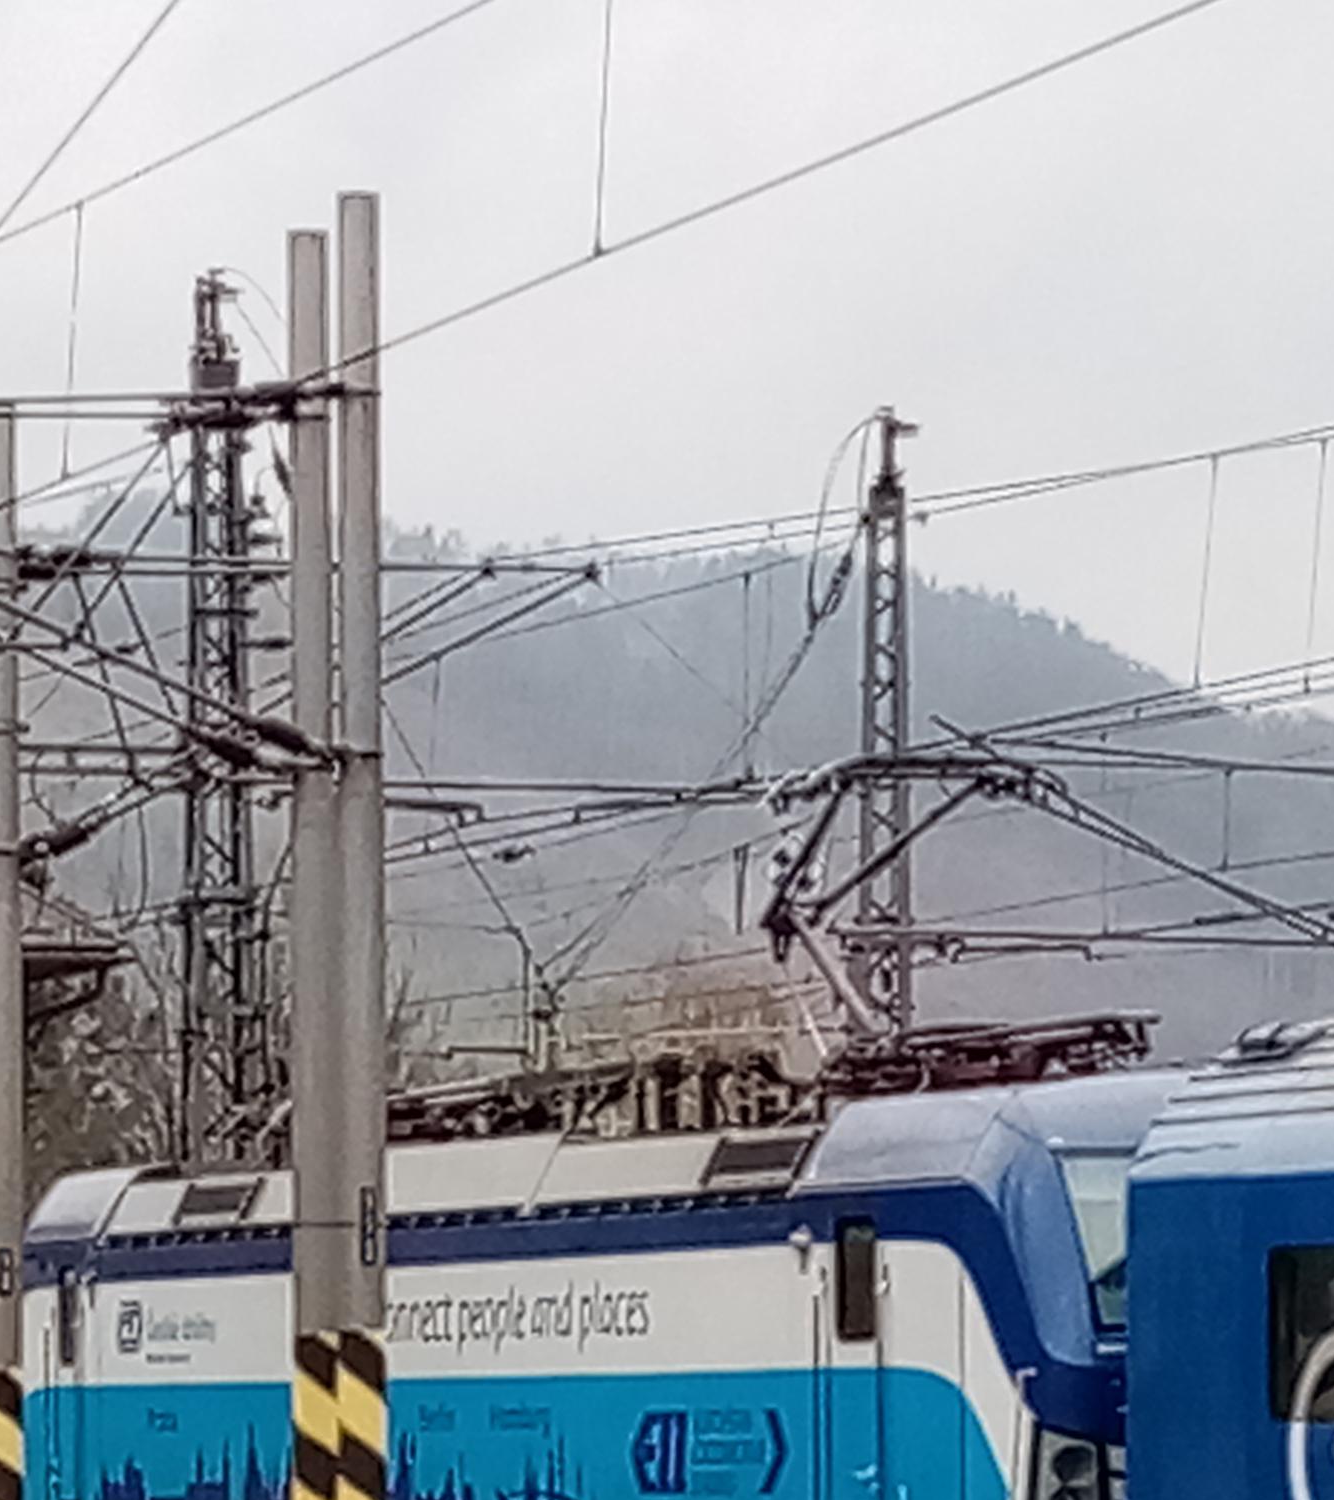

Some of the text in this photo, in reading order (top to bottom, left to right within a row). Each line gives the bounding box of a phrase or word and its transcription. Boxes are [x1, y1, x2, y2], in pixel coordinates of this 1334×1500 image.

[385, 1279, 649, 1355] onnect people and places
